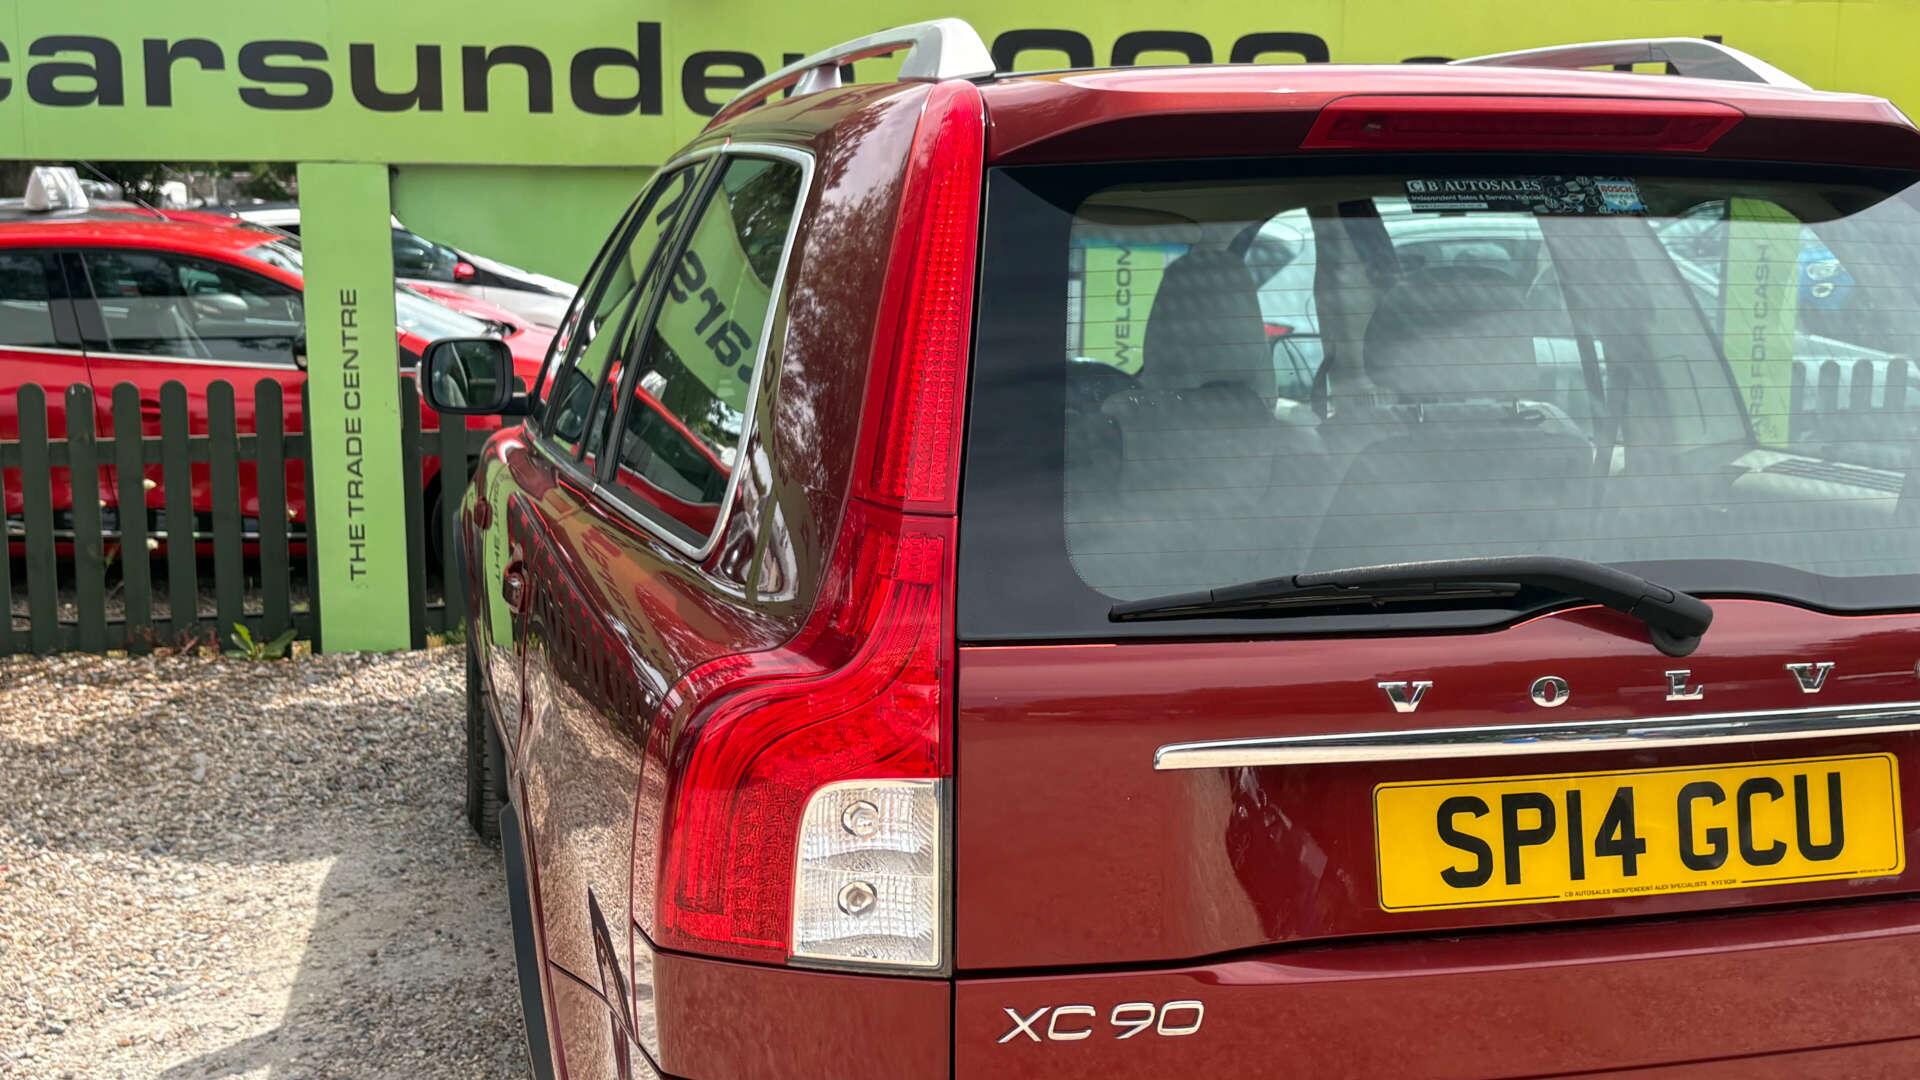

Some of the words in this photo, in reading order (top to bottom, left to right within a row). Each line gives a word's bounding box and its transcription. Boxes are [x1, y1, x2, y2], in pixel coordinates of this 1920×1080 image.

[1444, 180, 1541, 191] AUTOSALES
[1753, 244, 1770, 318] CASH
[340, 289, 361, 411] CENTRE
[1752, 325, 1767, 377] FOR
[1751, 384, 1764, 438] ARS
[345, 417, 364, 518] TRADE
[350, 523, 367, 580] THE
[1378, 657, 1920, 713] VOLV
[1436, 786, 1646, 889] SP14
[1677, 772, 1845, 872] GCU
[1575, 888, 1611, 897] AUTOSALES
[1612, 885, 1653, 894] INDEPENDENT
[1670, 881, 1707, 889] SPECIALISTS
[997, 1005, 1096, 1044] XC
[1109, 999, 1205, 1040] 90
